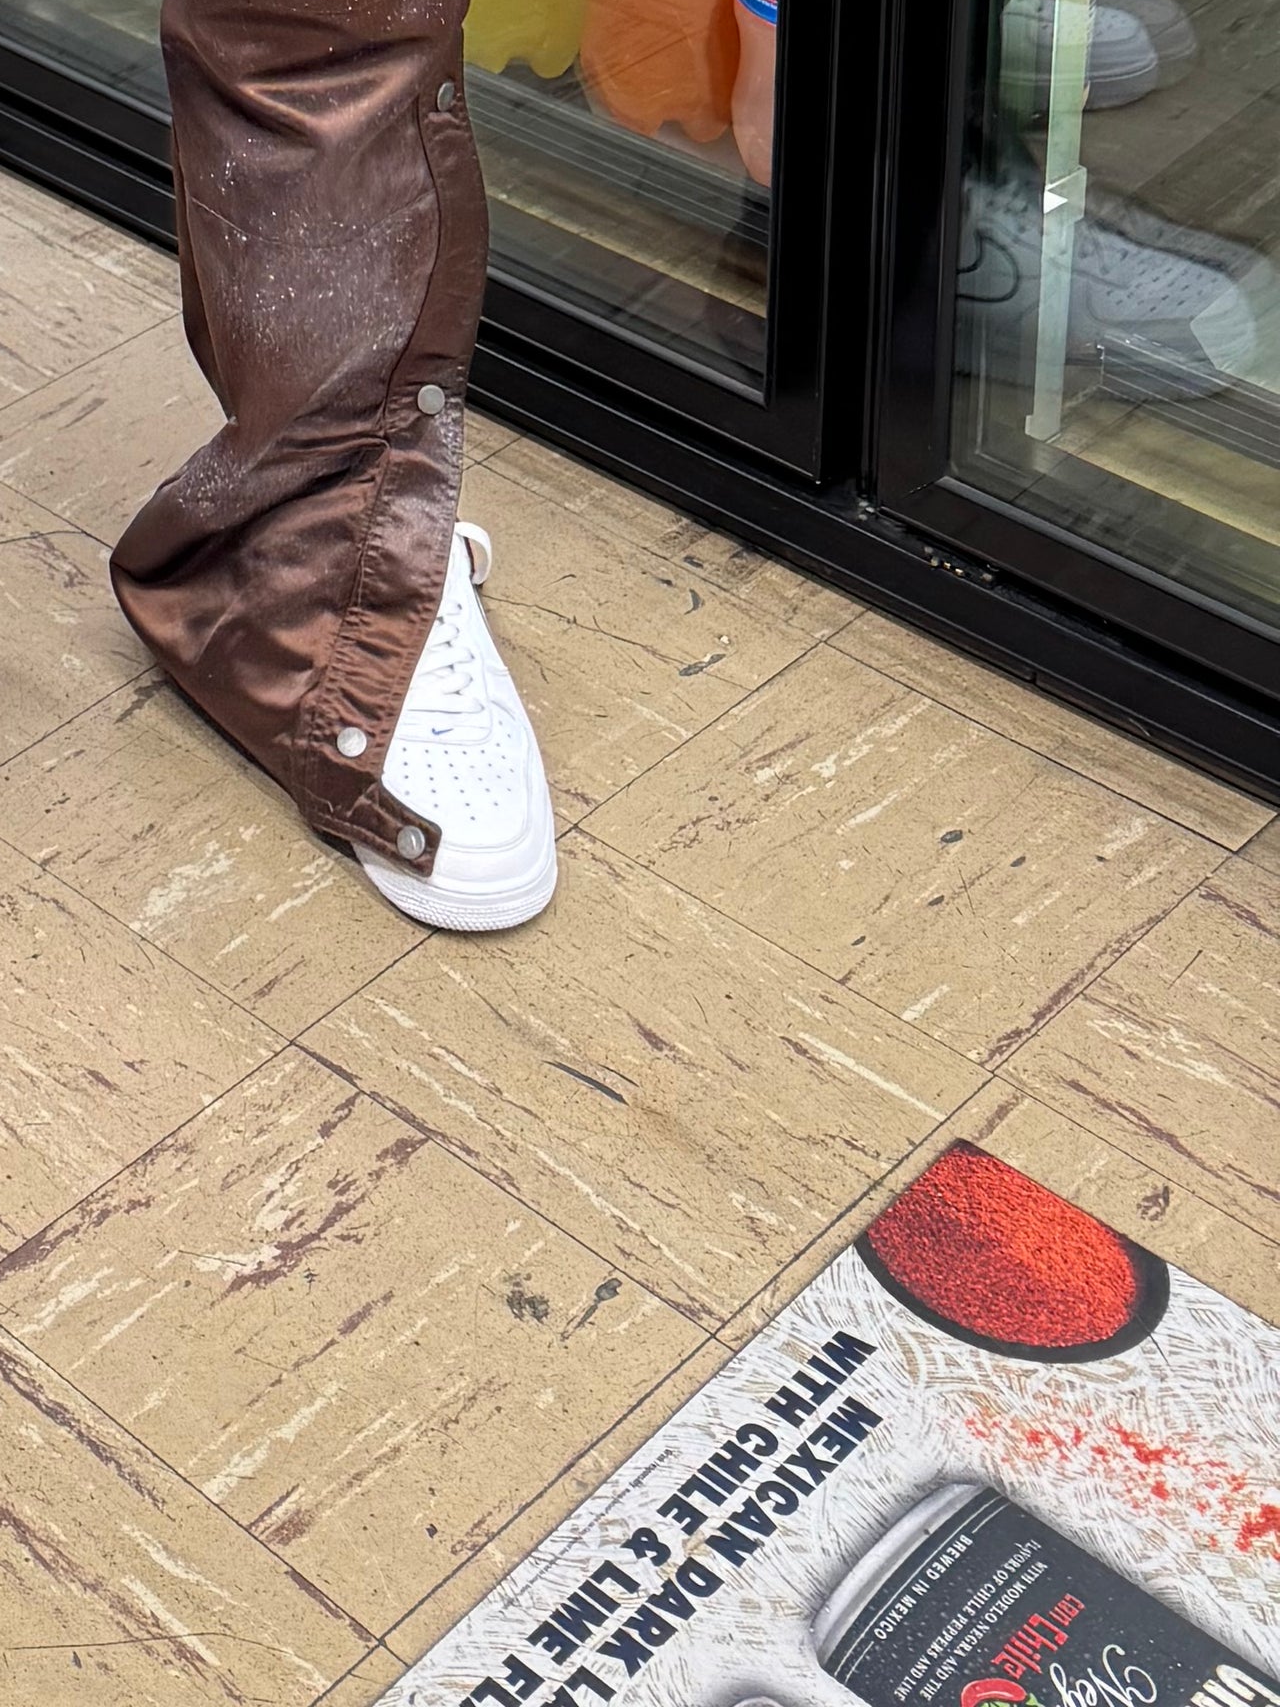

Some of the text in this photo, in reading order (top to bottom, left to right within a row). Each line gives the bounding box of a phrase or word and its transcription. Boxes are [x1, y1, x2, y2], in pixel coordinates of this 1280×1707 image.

[764, 1330, 878, 1428] WITH
[656, 1422, 779, 1536] CHILE
[596, 1396, 883, 1678] MEXICAN DARK
[621, 1526, 671, 1567] &
[873, 1533, 974, 1641] BREWED IN MEXICO
[526, 1559, 640, 1665] LIME
[912, 1567, 1010, 1682] OF CHILE PEPPERS AND
[918, 1575, 1028, 1703] MODELO NEGRA AND THE
[990, 1612, 1070, 1680] Chile
